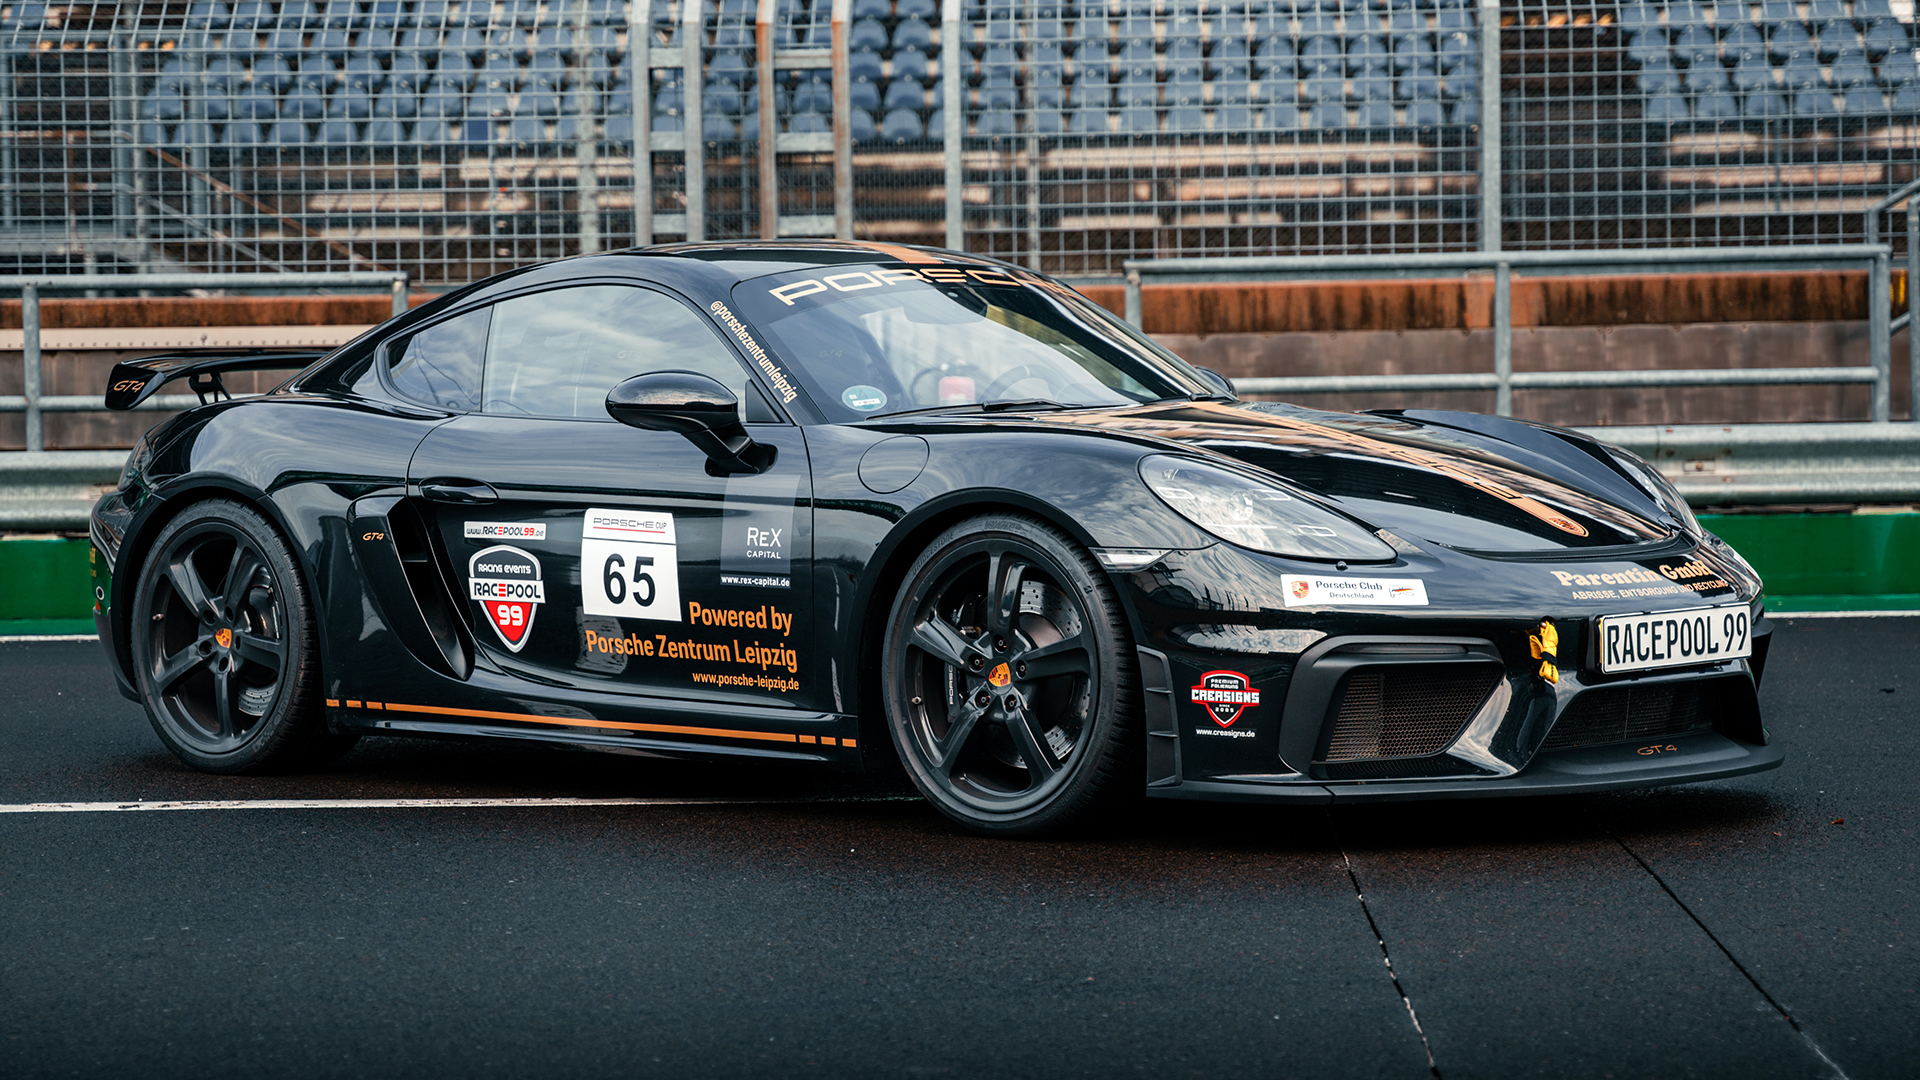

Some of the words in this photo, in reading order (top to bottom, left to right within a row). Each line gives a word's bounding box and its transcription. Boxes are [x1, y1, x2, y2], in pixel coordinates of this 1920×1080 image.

[710, 300, 798, 404] @porschezentrumleipzig
[113, 379, 145, 393] GT4
[593, 517, 654, 529] PORSCHE
[655, 521, 667, 530] CUP
[362, 532, 384, 542] GT4
[746, 549, 781, 560] CAPITAL
[603, 553, 656, 607] 65
[721, 576, 790, 588] www.rex-capital.de
[1550, 568, 1662, 587] Parentin
[1659, 560, 1714, 581] GmbH
[474, 582, 542, 599] RACEPOOL
[1315, 580, 1358, 590] Porsche
[1359, 582, 1383, 591] Club
[1572, 590, 1621, 600] ABRISSE,
[1621, 586, 1678, 599] ENTSORGUNG
[1678, 583, 1694, 594] UND
[497, 604, 523, 627] 99
[689, 601, 768, 630] Powered
[770, 606, 793, 637] by
[1606, 615, 1719, 666] RACEPOOL
[1723, 612, 1748, 652] 99
[585, 629, 655, 657] Porsche
[655, 634, 732, 662] Zentrum
[733, 639, 799, 674] Leipzig
[692, 672, 800, 692] www.porsche-leipzig.de
[1191, 689, 1260, 703] CREASIGNS
[1195, 729, 1256, 739] www.creasigns.de
[1637, 744, 1678, 756] GT4
